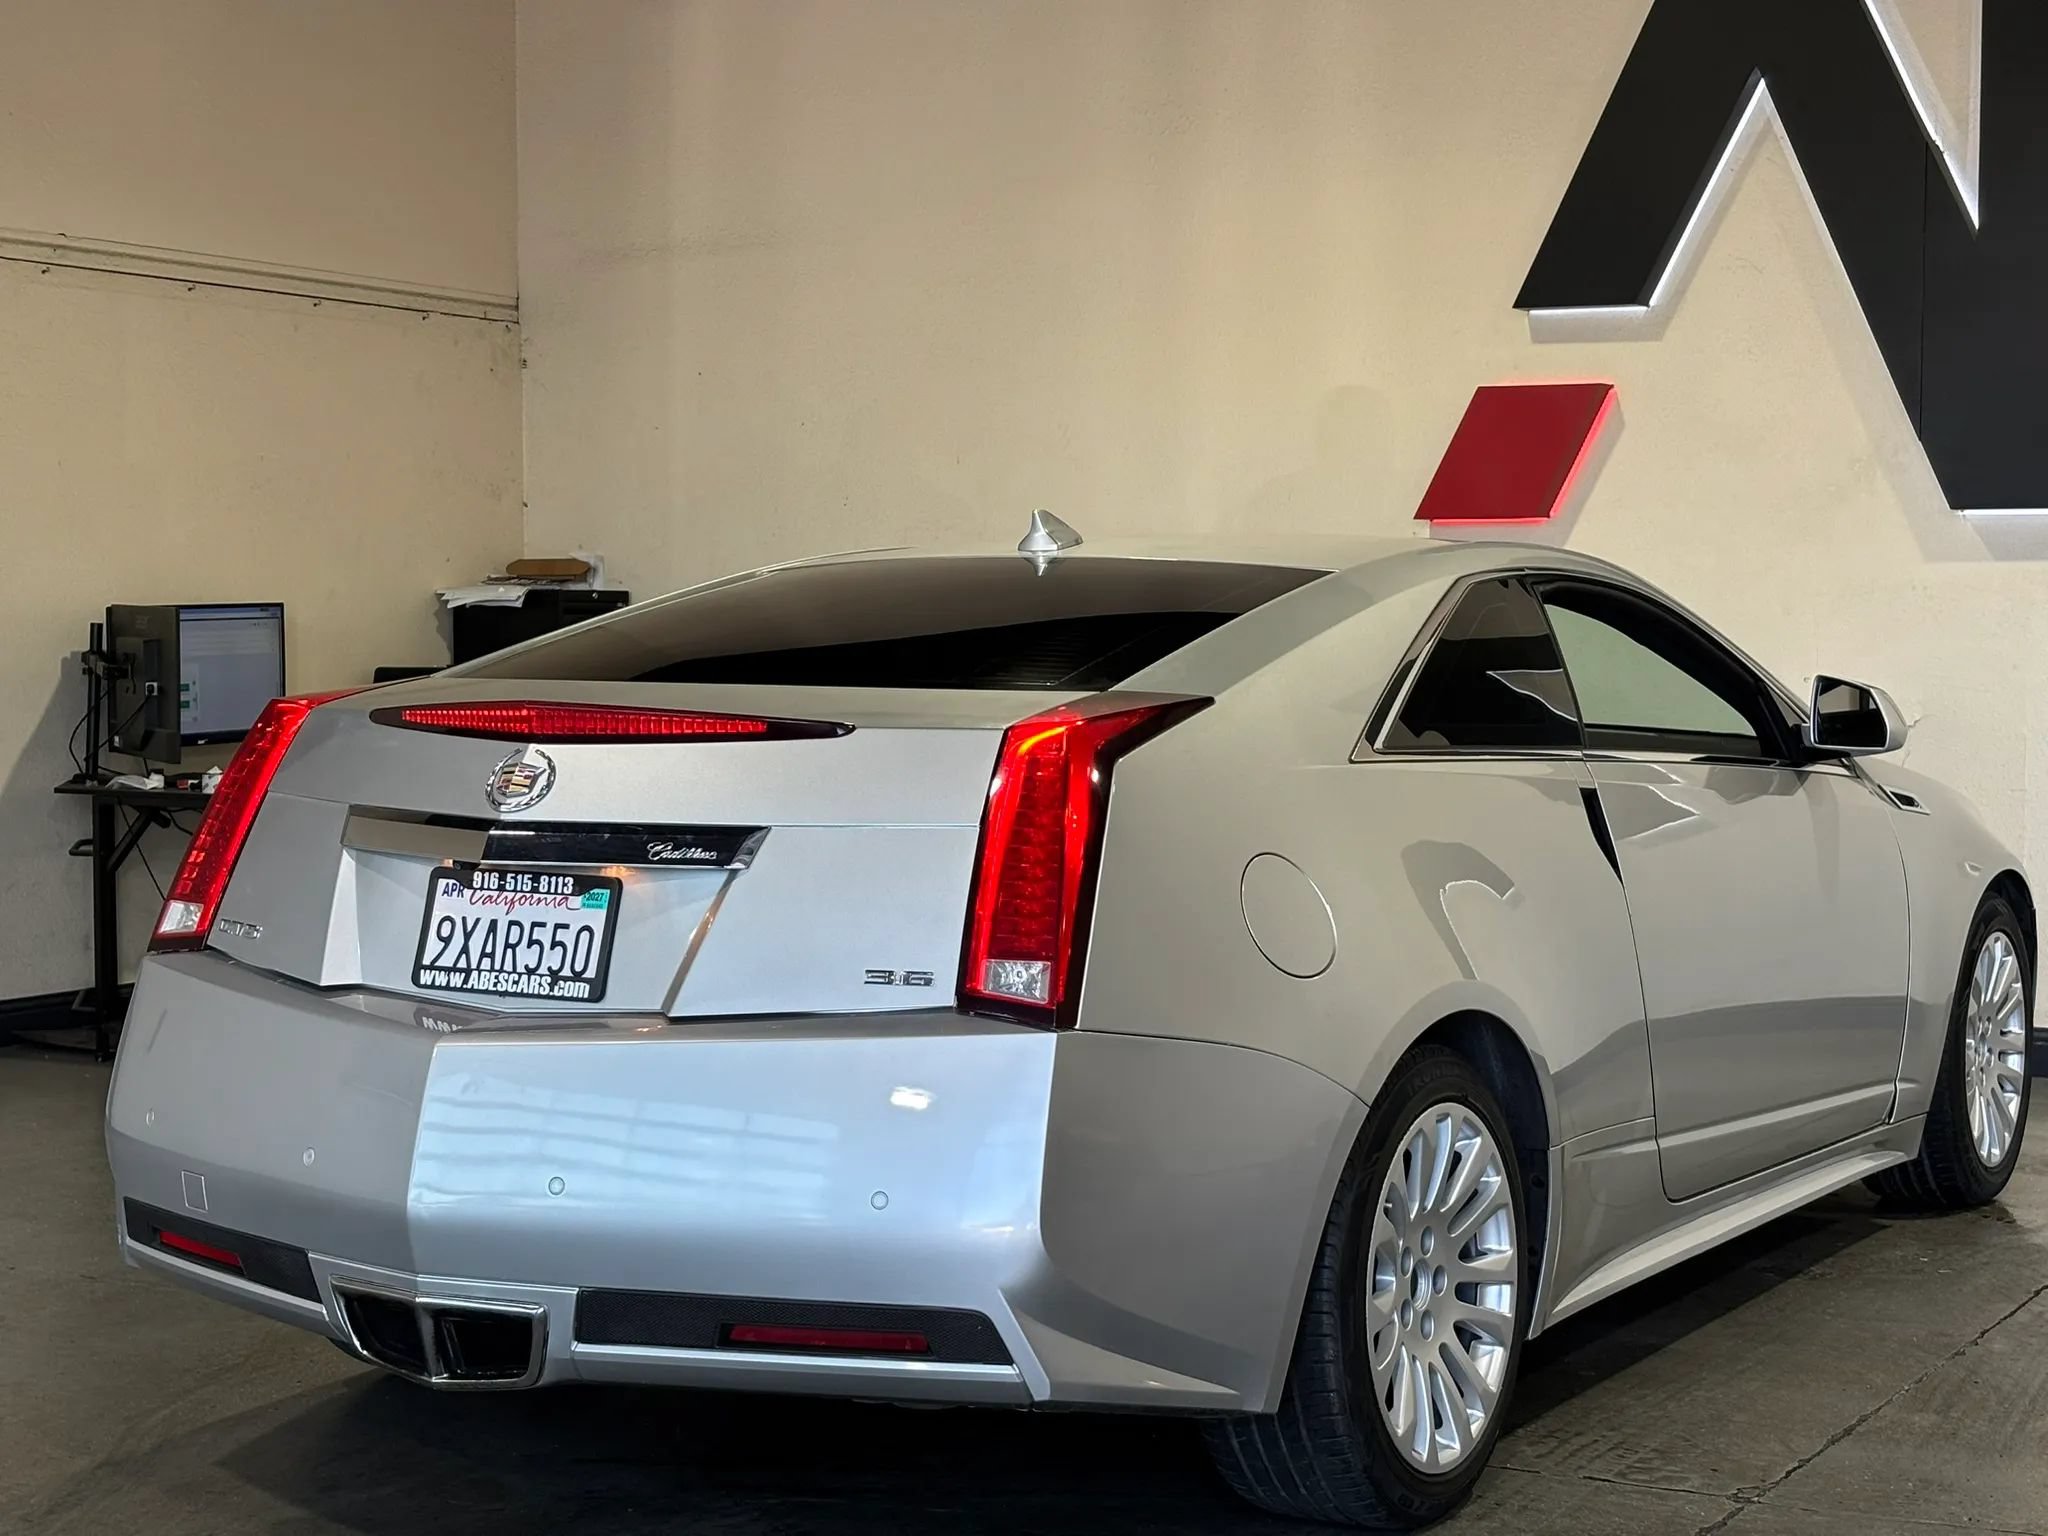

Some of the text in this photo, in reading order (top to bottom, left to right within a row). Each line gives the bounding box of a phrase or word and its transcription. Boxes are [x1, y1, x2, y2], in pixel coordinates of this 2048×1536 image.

[441, 882, 465, 899] APR
[472, 871, 574, 894] 916-515-8113
[469, 888, 581, 916] California
[431, 915, 595, 977] 9XAR550
[419, 968, 591, 998] www.ABESCARS.com
[864, 969, 934, 987] 3.6
